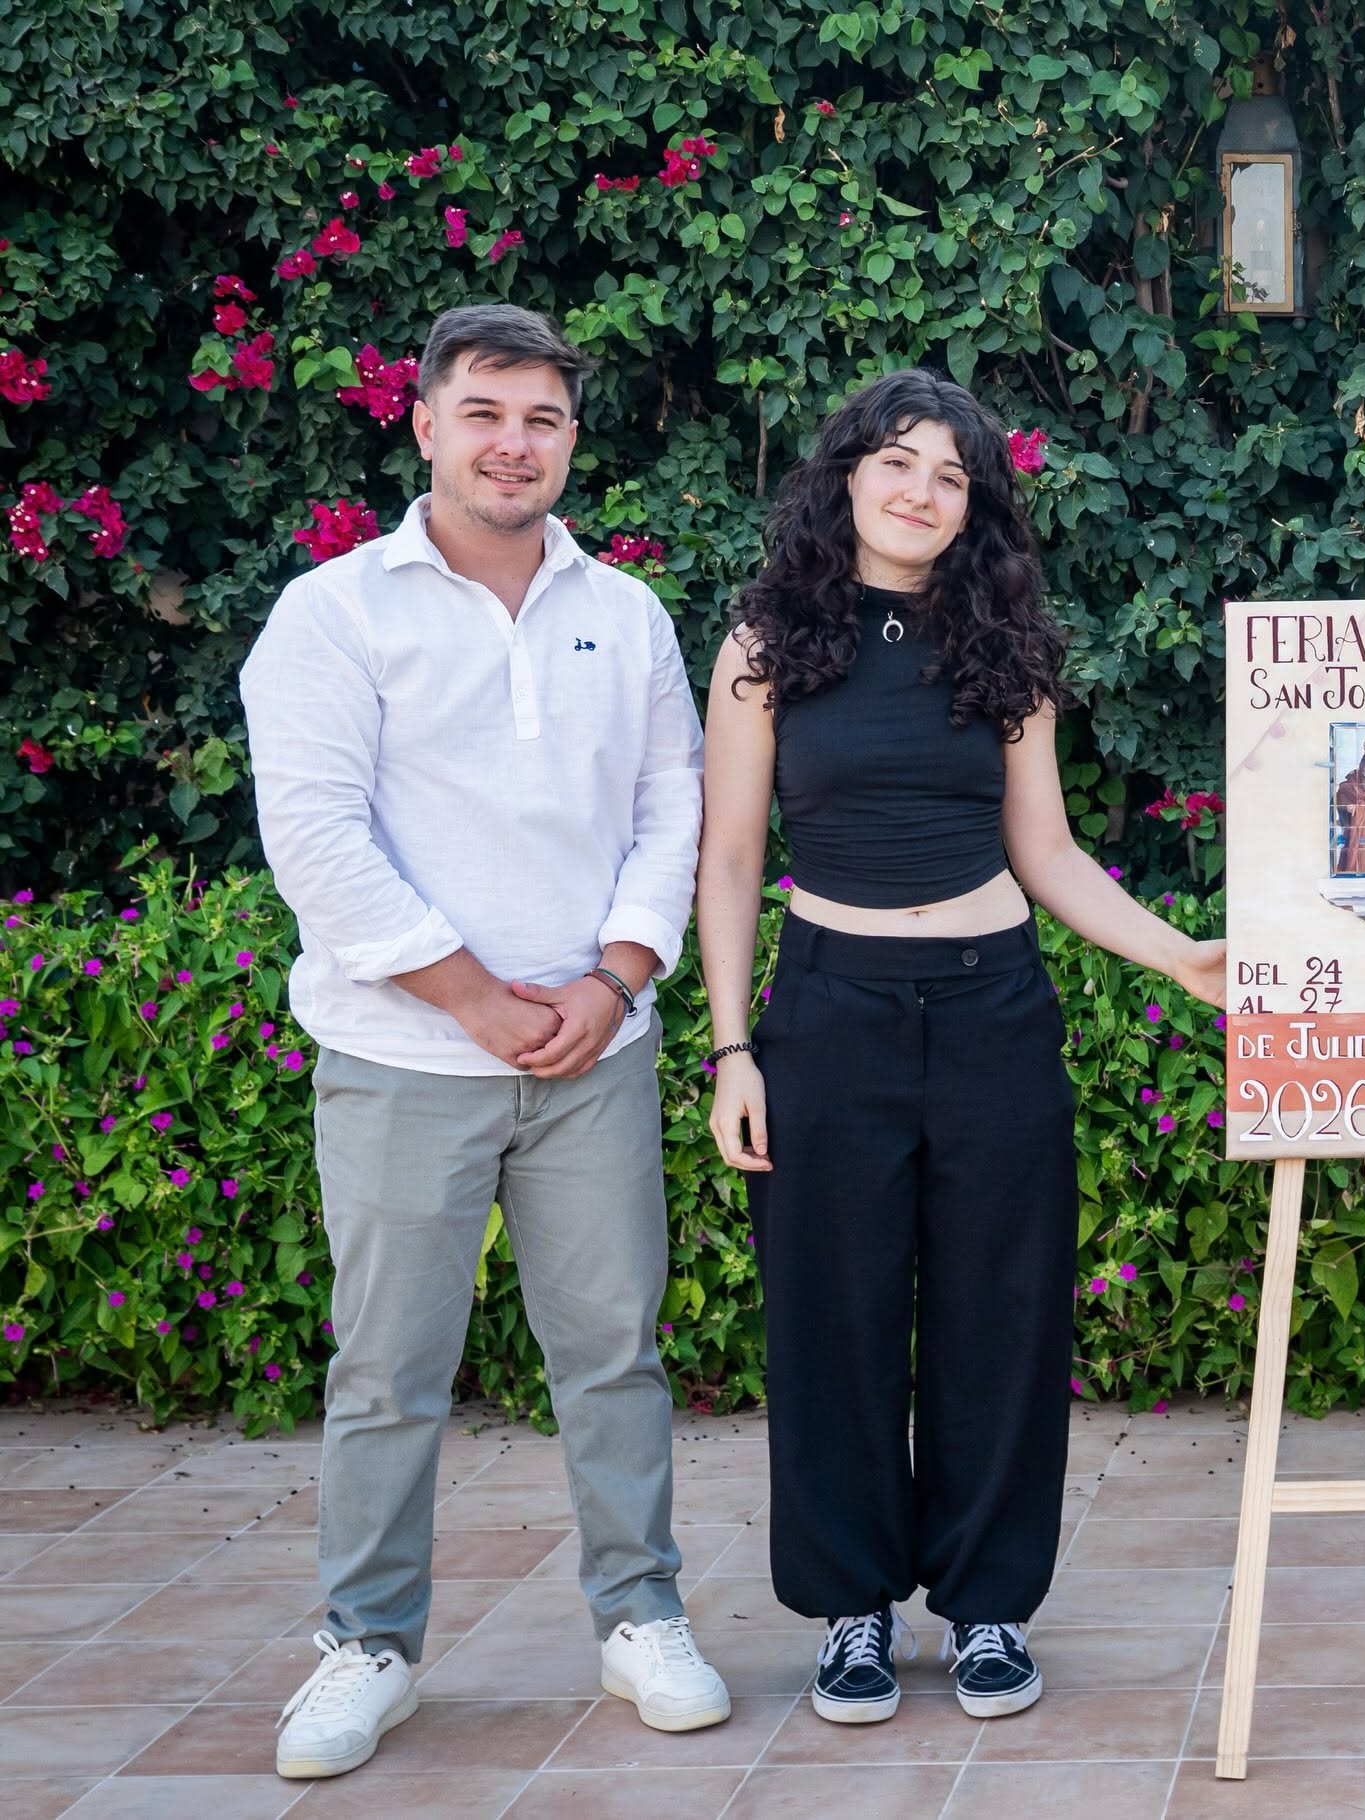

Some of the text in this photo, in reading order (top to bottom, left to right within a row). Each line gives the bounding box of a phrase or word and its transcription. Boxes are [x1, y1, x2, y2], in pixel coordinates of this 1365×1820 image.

[1250, 668, 1312, 710] SAN
[1238, 956, 1343, 986] DEL 24
[1238, 987, 1343, 1014] AL 27
[1237, 1033, 1276, 1059] DE
